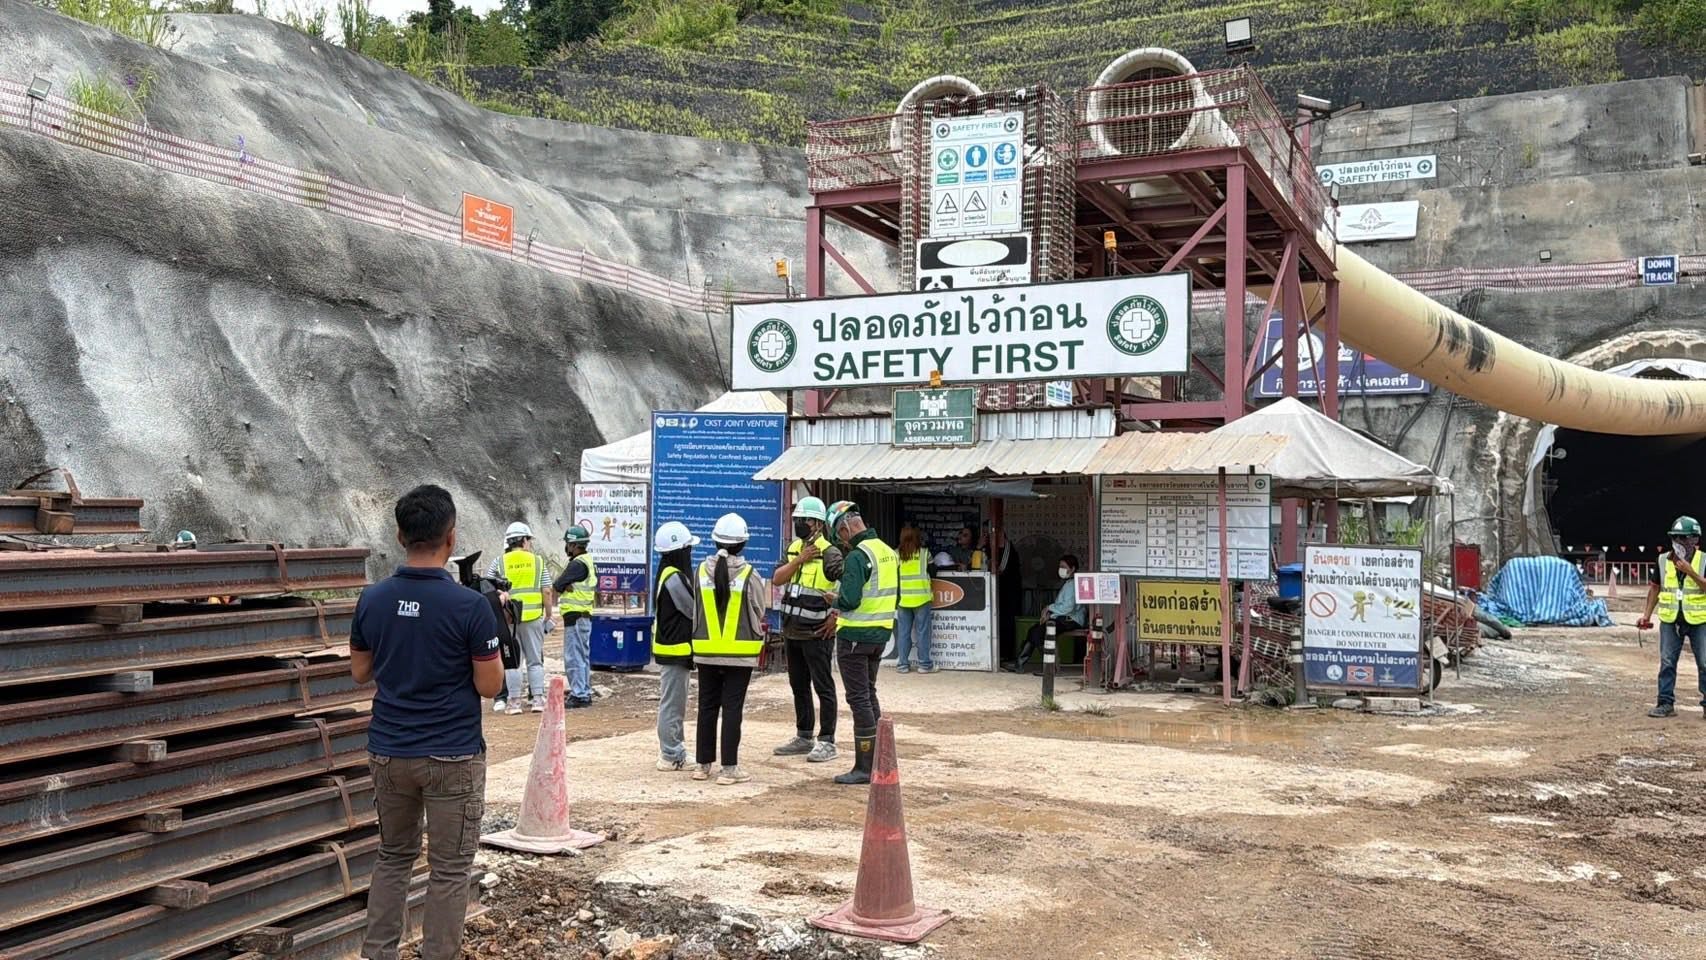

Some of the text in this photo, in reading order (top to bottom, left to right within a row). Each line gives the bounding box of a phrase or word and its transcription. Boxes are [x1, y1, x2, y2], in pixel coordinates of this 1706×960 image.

[952, 121, 1002, 133] SAFETY FIRST
[1339, 160, 1412, 175] ปลอดภัยไว้ก่อน
[1339, 170, 1411, 185] SAFETY FIRST
[1647, 259, 1672, 269] DOWN
[1645, 272, 1673, 282] TRACK
[813, 293, 1088, 344] ปลอดภัยไว้ก่อน
[1113, 333, 1160, 353] Safety First
[813, 340, 1085, 381] SAFETY FIRST
[703, 419, 779, 428] CKST JOINT VENTURE
[904, 420, 964, 435] จุดรวมพล
[667, 453, 682, 462] Safety
[758, 455, 773, 463] Entry
[1313, 551, 1351, 566] อันตราย
[1361, 552, 1414, 568] เขตก่อสร้าง
[594, 564, 646, 575] ในความไม่สะดวก
[1306, 569, 1420, 593] ห้ามเข้าก่อนได้รับอนุญาต
[398, 600, 420, 612] 7HD
[932, 623, 986, 633] อนได้รับอนุญาต
[1143, 619, 1222, 637] อันตรายห้ามเข้
[1307, 628, 1337, 637] DANGER
[1341, 629, 1398, 639] CONSTRUCTION
[1397, 631, 1416, 640] AREA
[486, 637, 499, 649] 7HD
[950, 642, 976, 650] SPACE
[1336, 640, 1387, 649] DO NOT ENTER
[1305, 650, 1418, 666] ขออภัยในความไม่สะดวก
